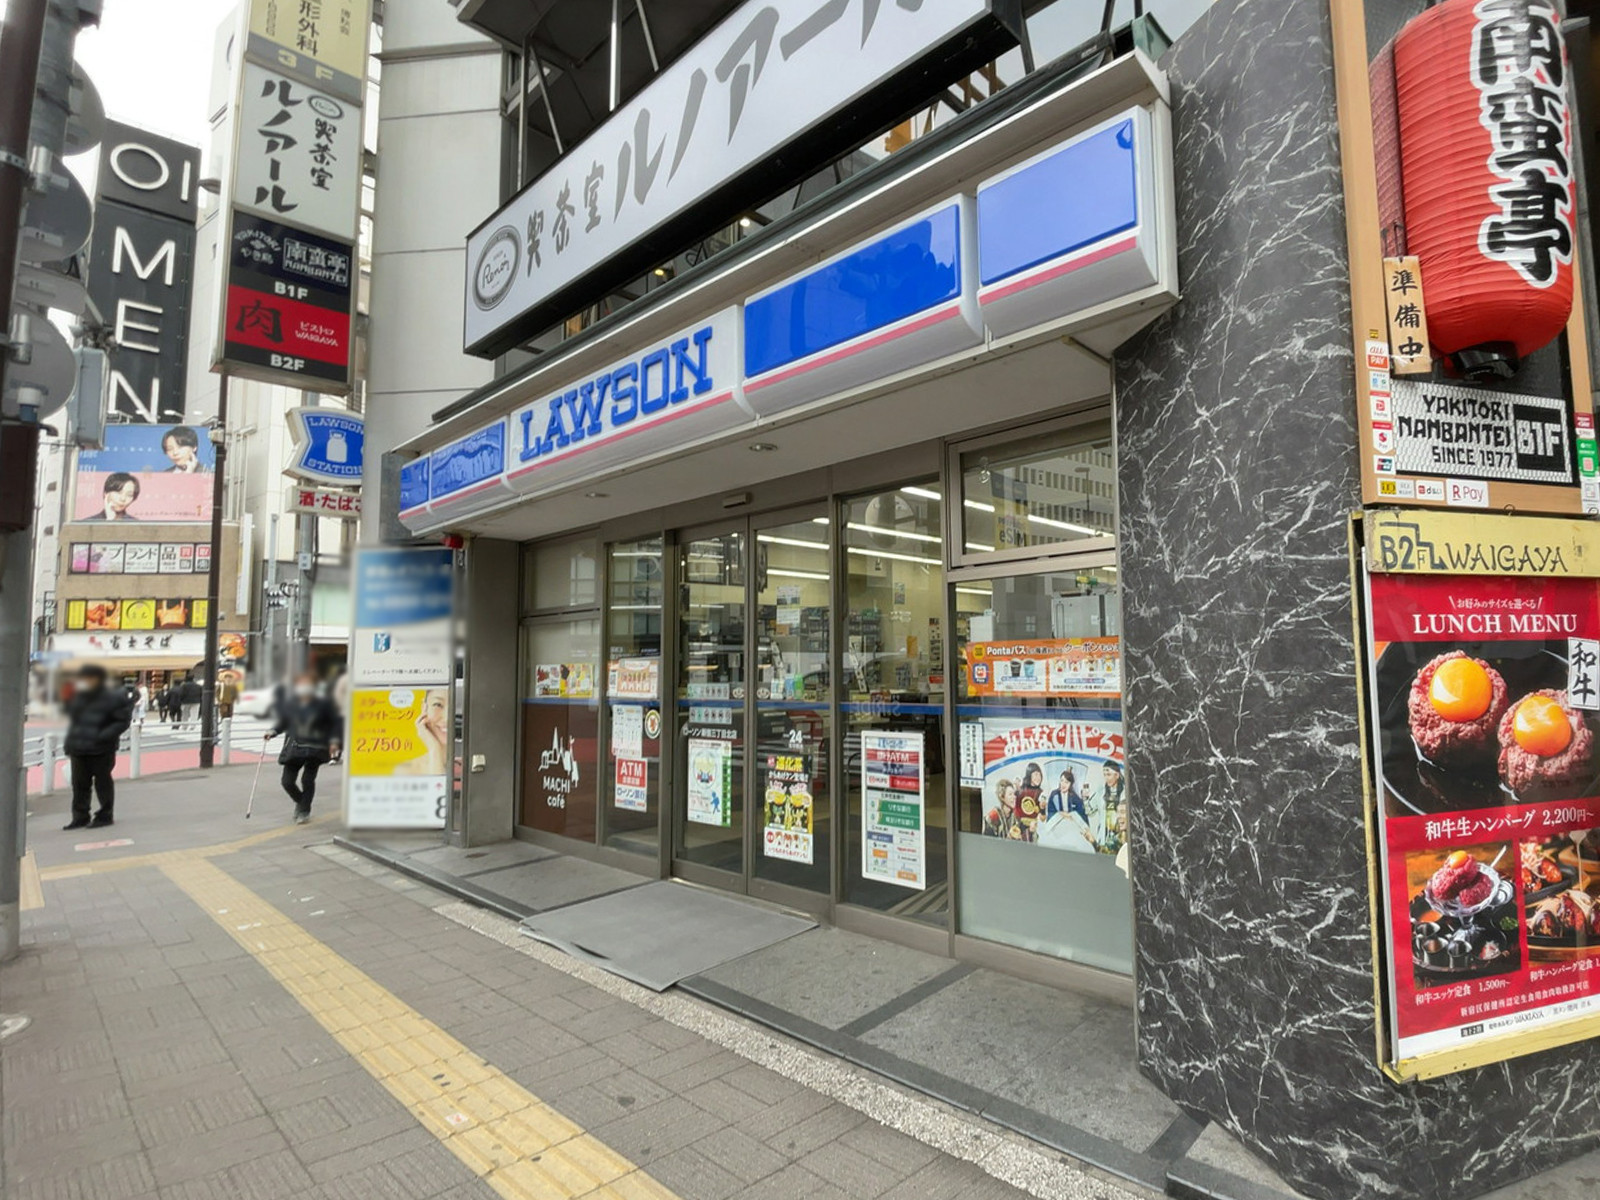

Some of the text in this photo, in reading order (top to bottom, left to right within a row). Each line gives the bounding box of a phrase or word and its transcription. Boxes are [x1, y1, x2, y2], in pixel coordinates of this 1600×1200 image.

[254, 79, 304, 213] ルノアール
[526, 0, 925, 277] 喫茶室 ルノアー
[308, 118, 337, 191] 喫茶室
[274, 281, 308, 300] B1F
[235, 299, 283, 344] 肉
[1391, 269, 1424, 363] 準備中
[270, 353, 305, 371] B2F
[519, 325, 713, 463] LAWSON
[1422, 394, 1509, 421] YAKITORI
[1517, 419, 1561, 458] B1F
[1432, 445, 1513, 469] SINCE 1977
[1463, 486, 1484, 502] Pay
[1445, 543, 1568, 572] WAIGAYA
[1413, 613, 1578, 634] LUNCH MENU
[1572, 642, 1597, 705] 和牛
[620, 761, 643, 777] ATM
[543, 776, 570, 793] MACHI
[547, 793, 565, 809] café
[1425, 808, 1537, 841] 和牛生ハンバーグ
[1416, 983, 1472, 1006] 和牛ユッケ定食
